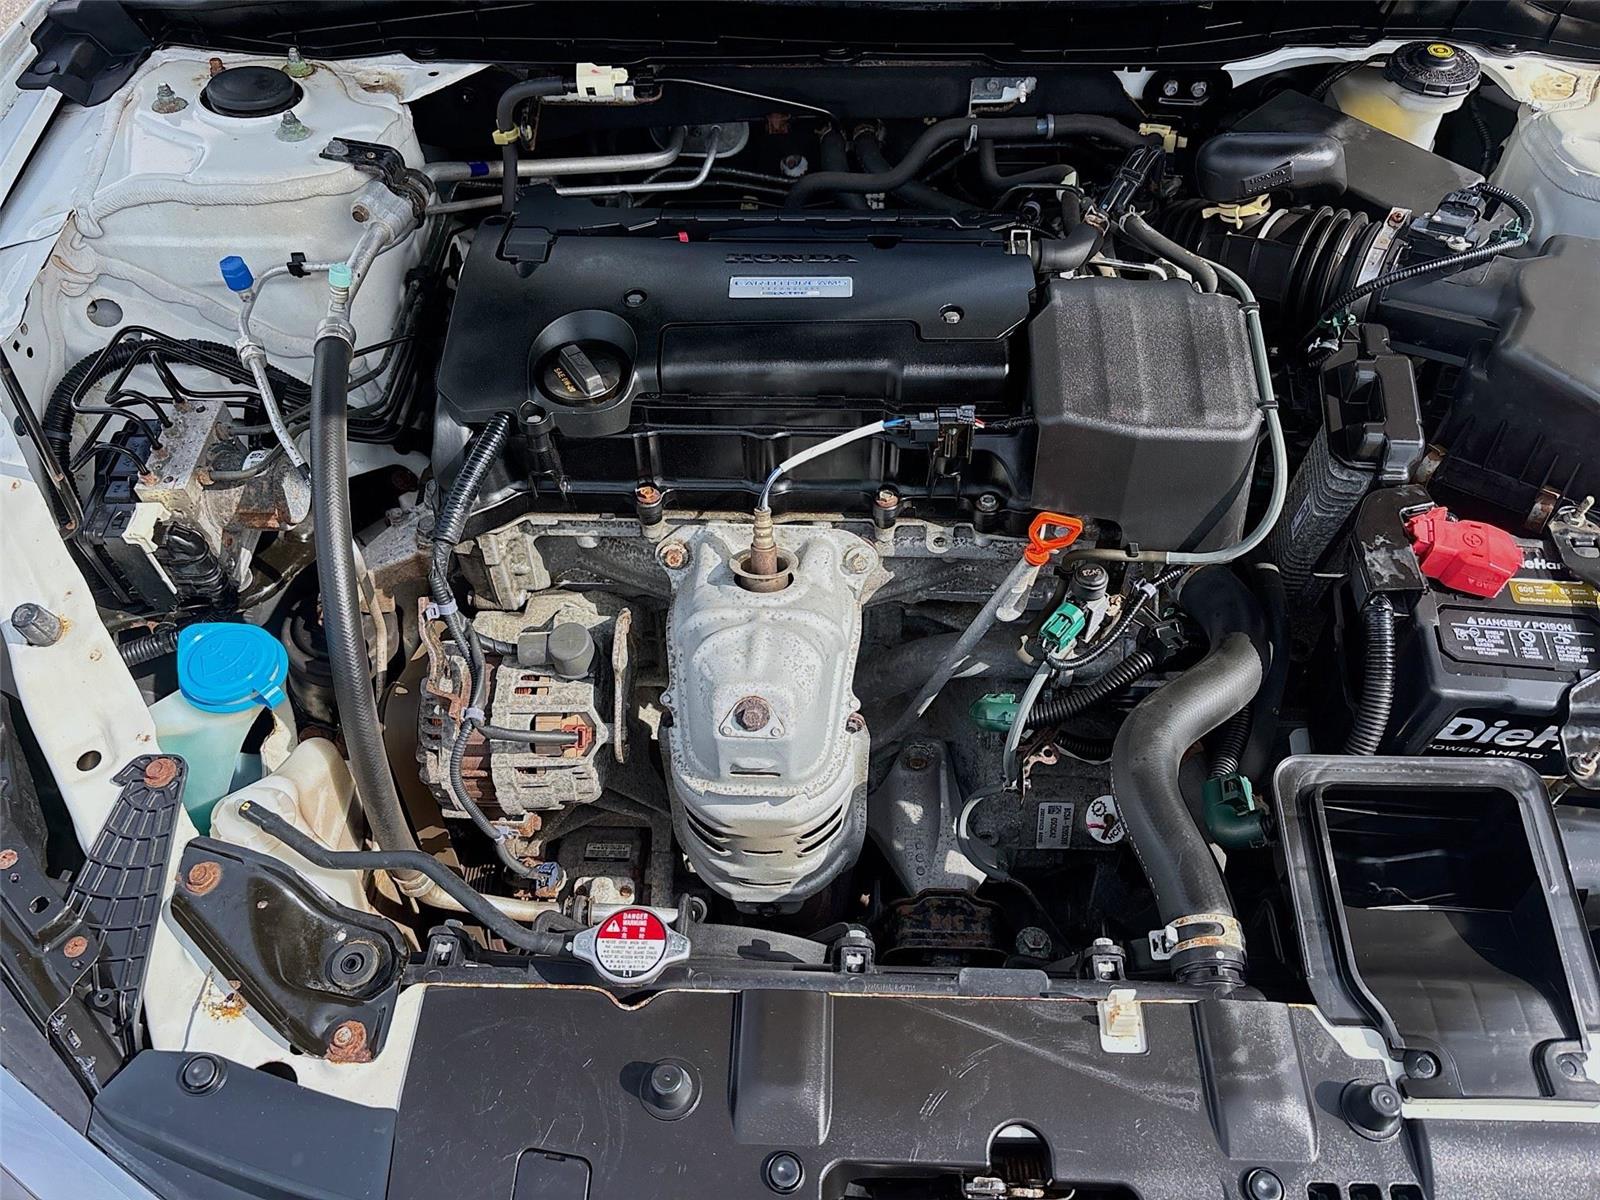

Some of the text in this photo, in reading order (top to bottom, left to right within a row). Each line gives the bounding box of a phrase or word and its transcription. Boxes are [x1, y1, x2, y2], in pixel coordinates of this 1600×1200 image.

[725, 254, 859, 263] HONDA
[553, 367, 566, 379] SAE
[1477, 617, 1522, 628] DANGER
[1531, 621, 1572, 631] POISON
[1484, 749, 1545, 760] AHEAD
